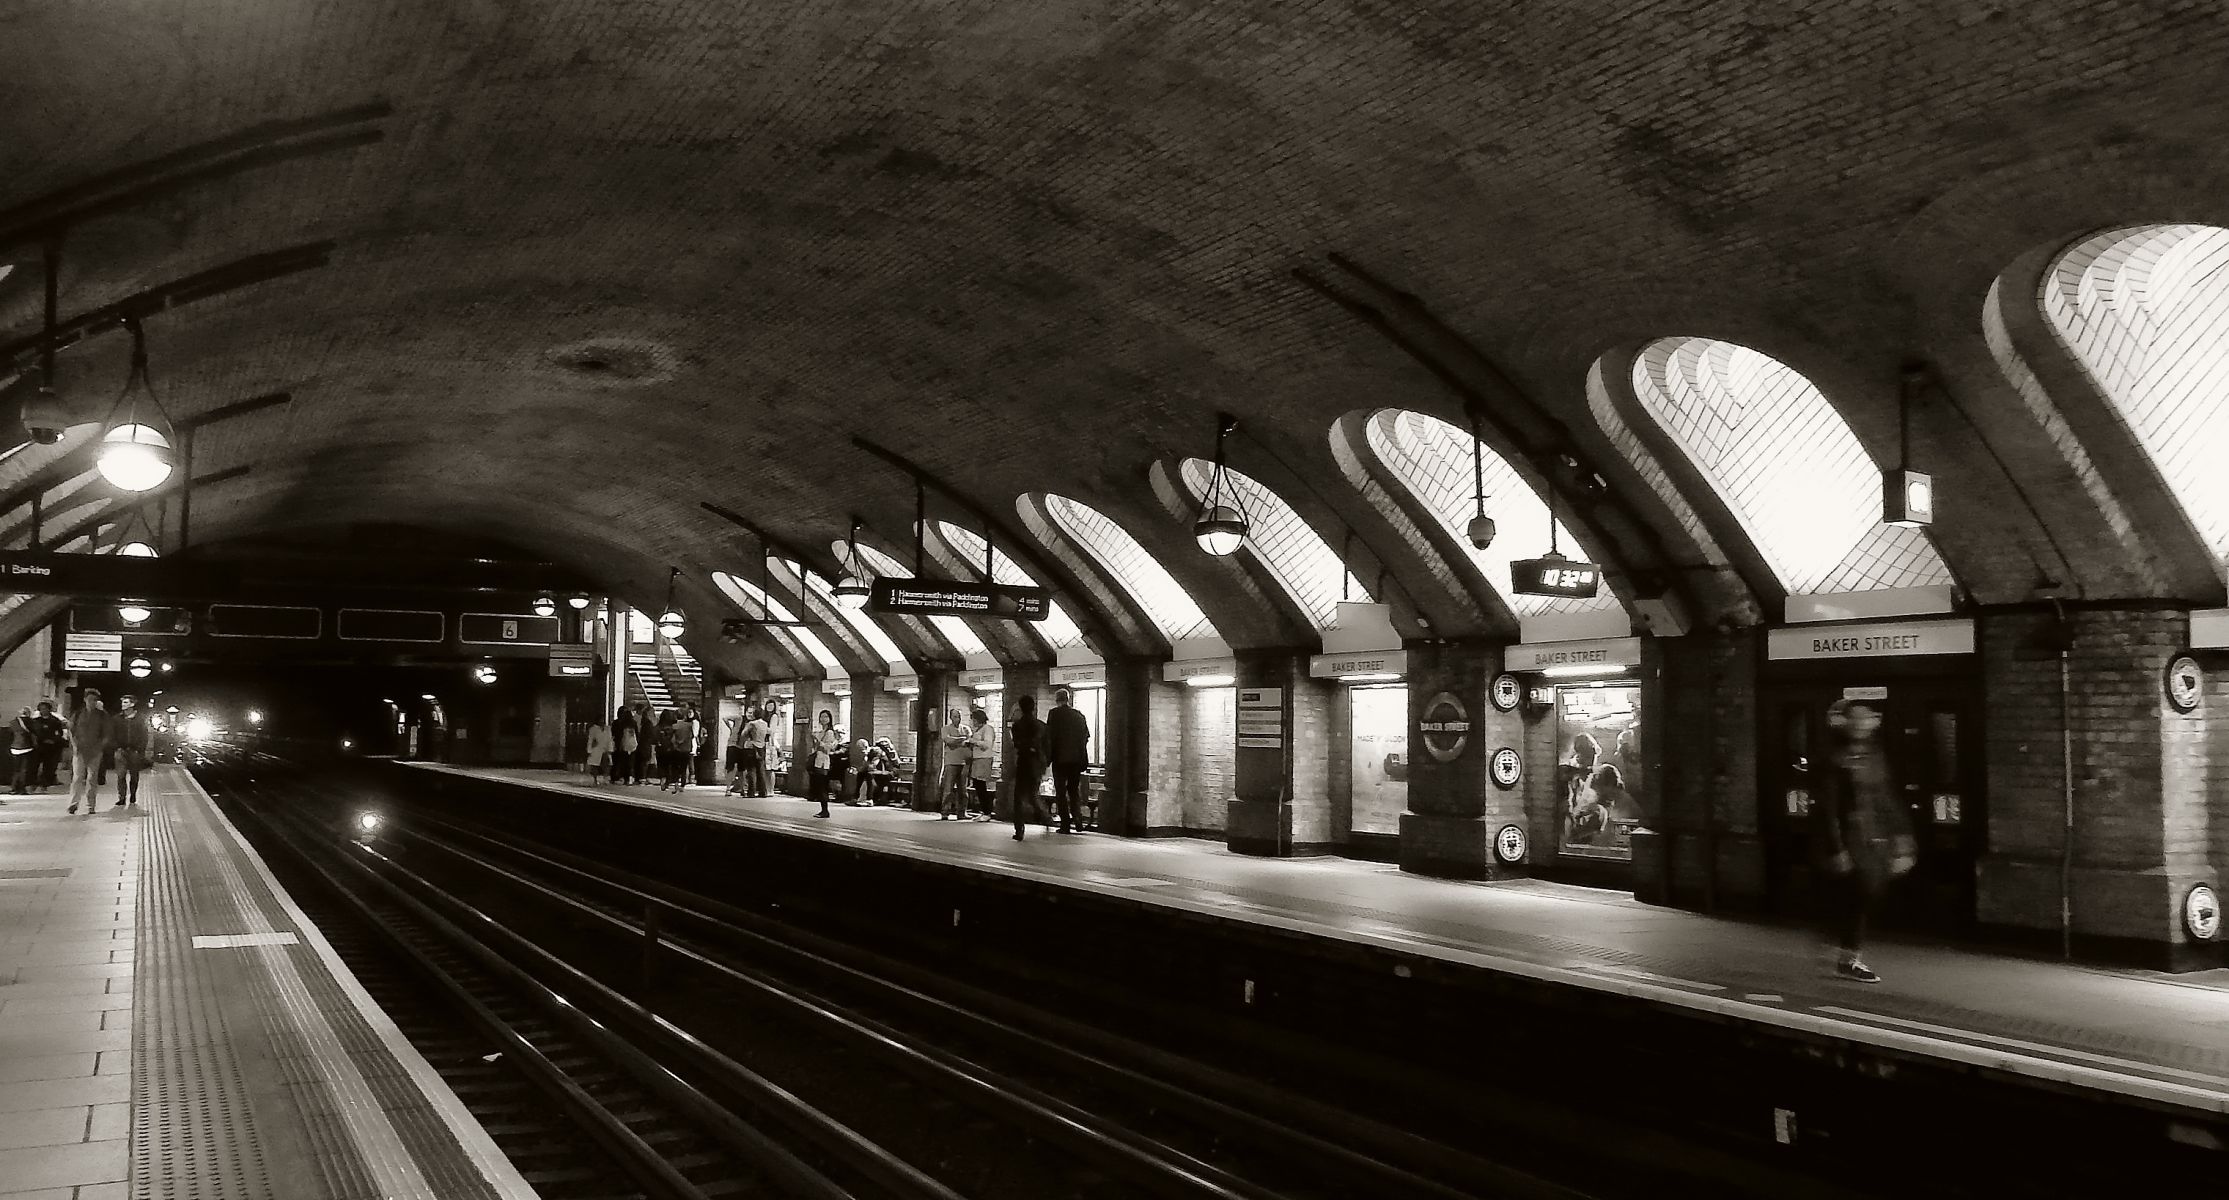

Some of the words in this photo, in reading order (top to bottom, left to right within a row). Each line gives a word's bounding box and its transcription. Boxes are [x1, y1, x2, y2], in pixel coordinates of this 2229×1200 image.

[12, 564, 50, 575] Barking
[898, 589, 942, 599] Hammersmith
[953, 592, 989, 602] Paddington
[897, 597, 942, 607] Hammersmith
[952, 600, 988, 609] Paddington
[1813, 638, 1859, 652] BAKER
[1864, 635, 1920, 650] STREET
[1535, 652, 1568, 665] BAKER
[1571, 650, 1607, 662] STREET
[1331, 661, 1356, 672] BAKER
[1357, 660, 1385, 671] STREET
[1420, 722, 1443, 731] BAKER
[1444, 722, 1469, 731] STREET
